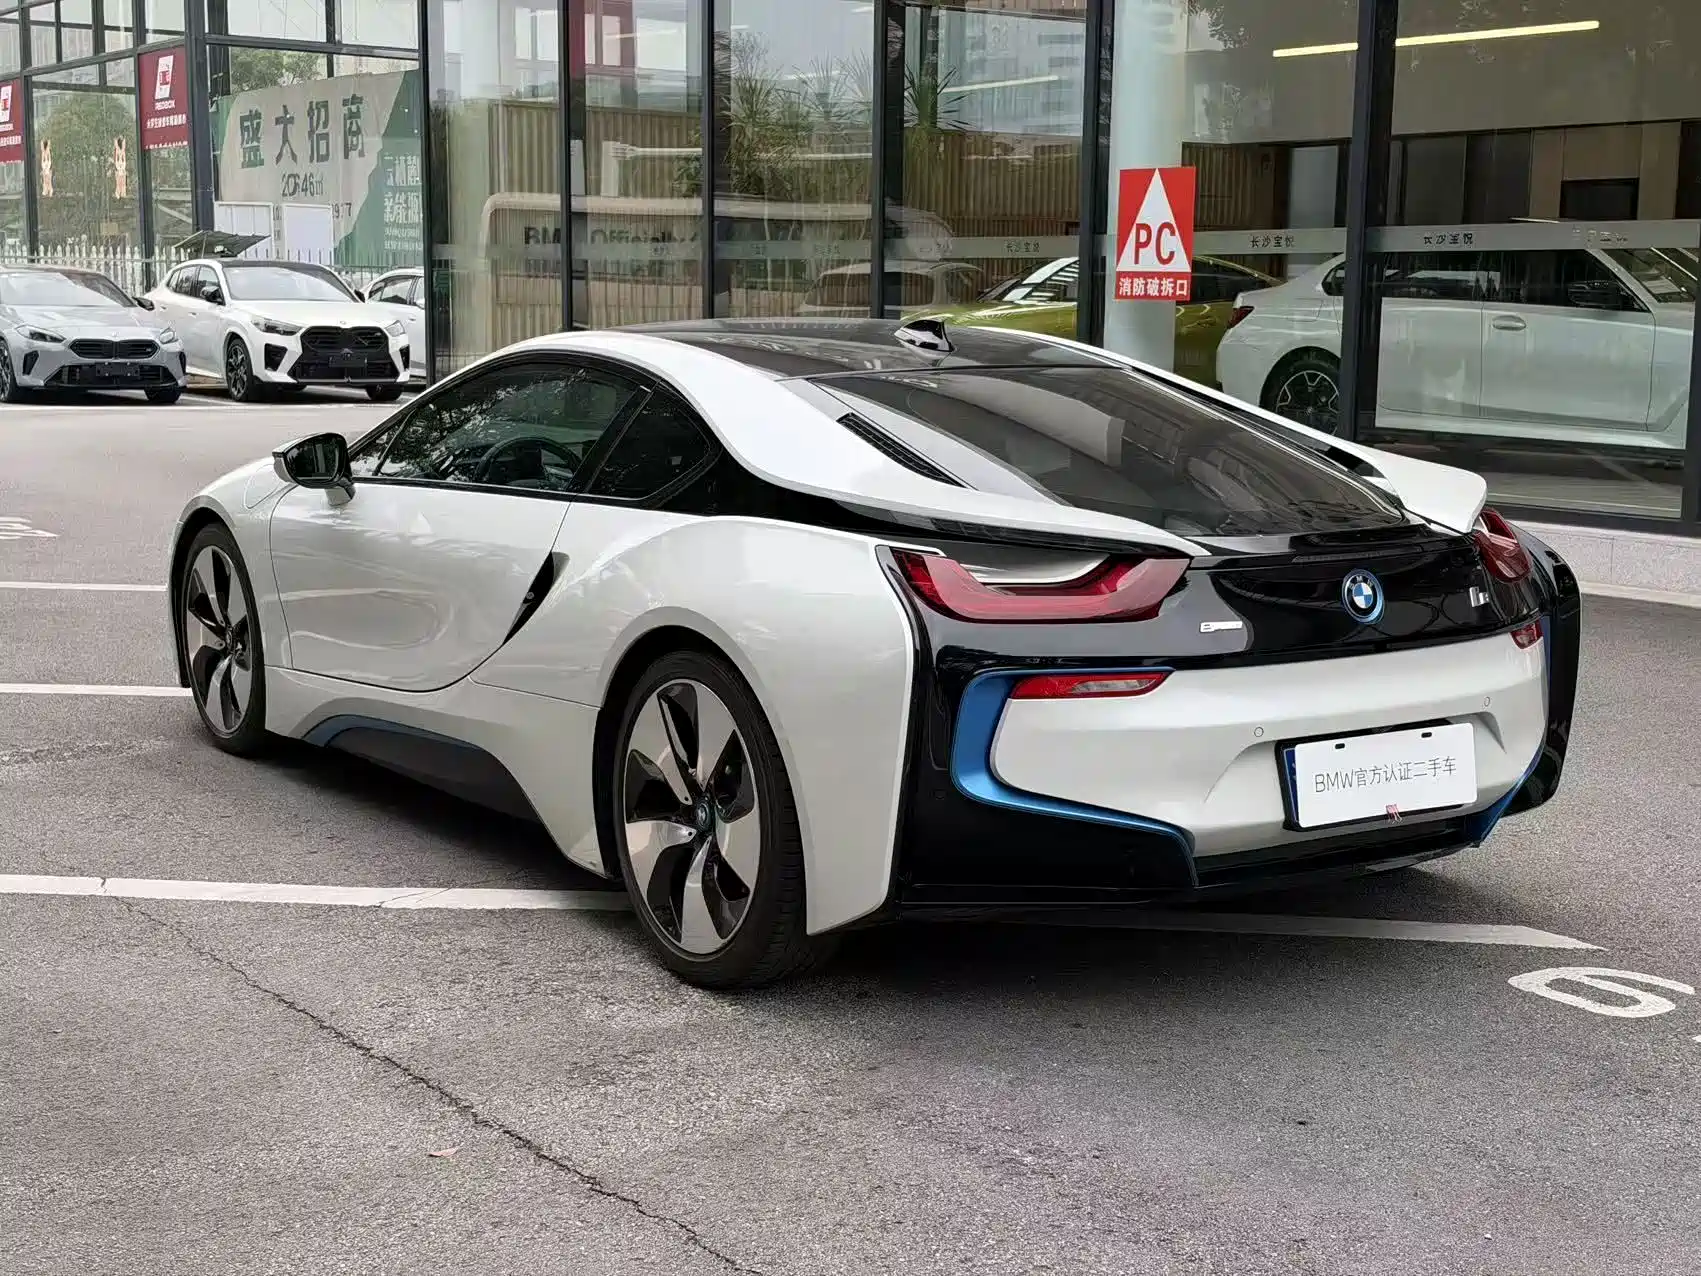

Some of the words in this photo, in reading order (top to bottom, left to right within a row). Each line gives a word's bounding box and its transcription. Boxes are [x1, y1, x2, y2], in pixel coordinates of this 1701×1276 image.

[239, 93, 365, 168] 盛大招商
[1134, 221, 1176, 266] PC
[1118, 277, 1188, 297] 消防破拆口
[1314, 755, 1457, 793] BMW官方认证二手车
